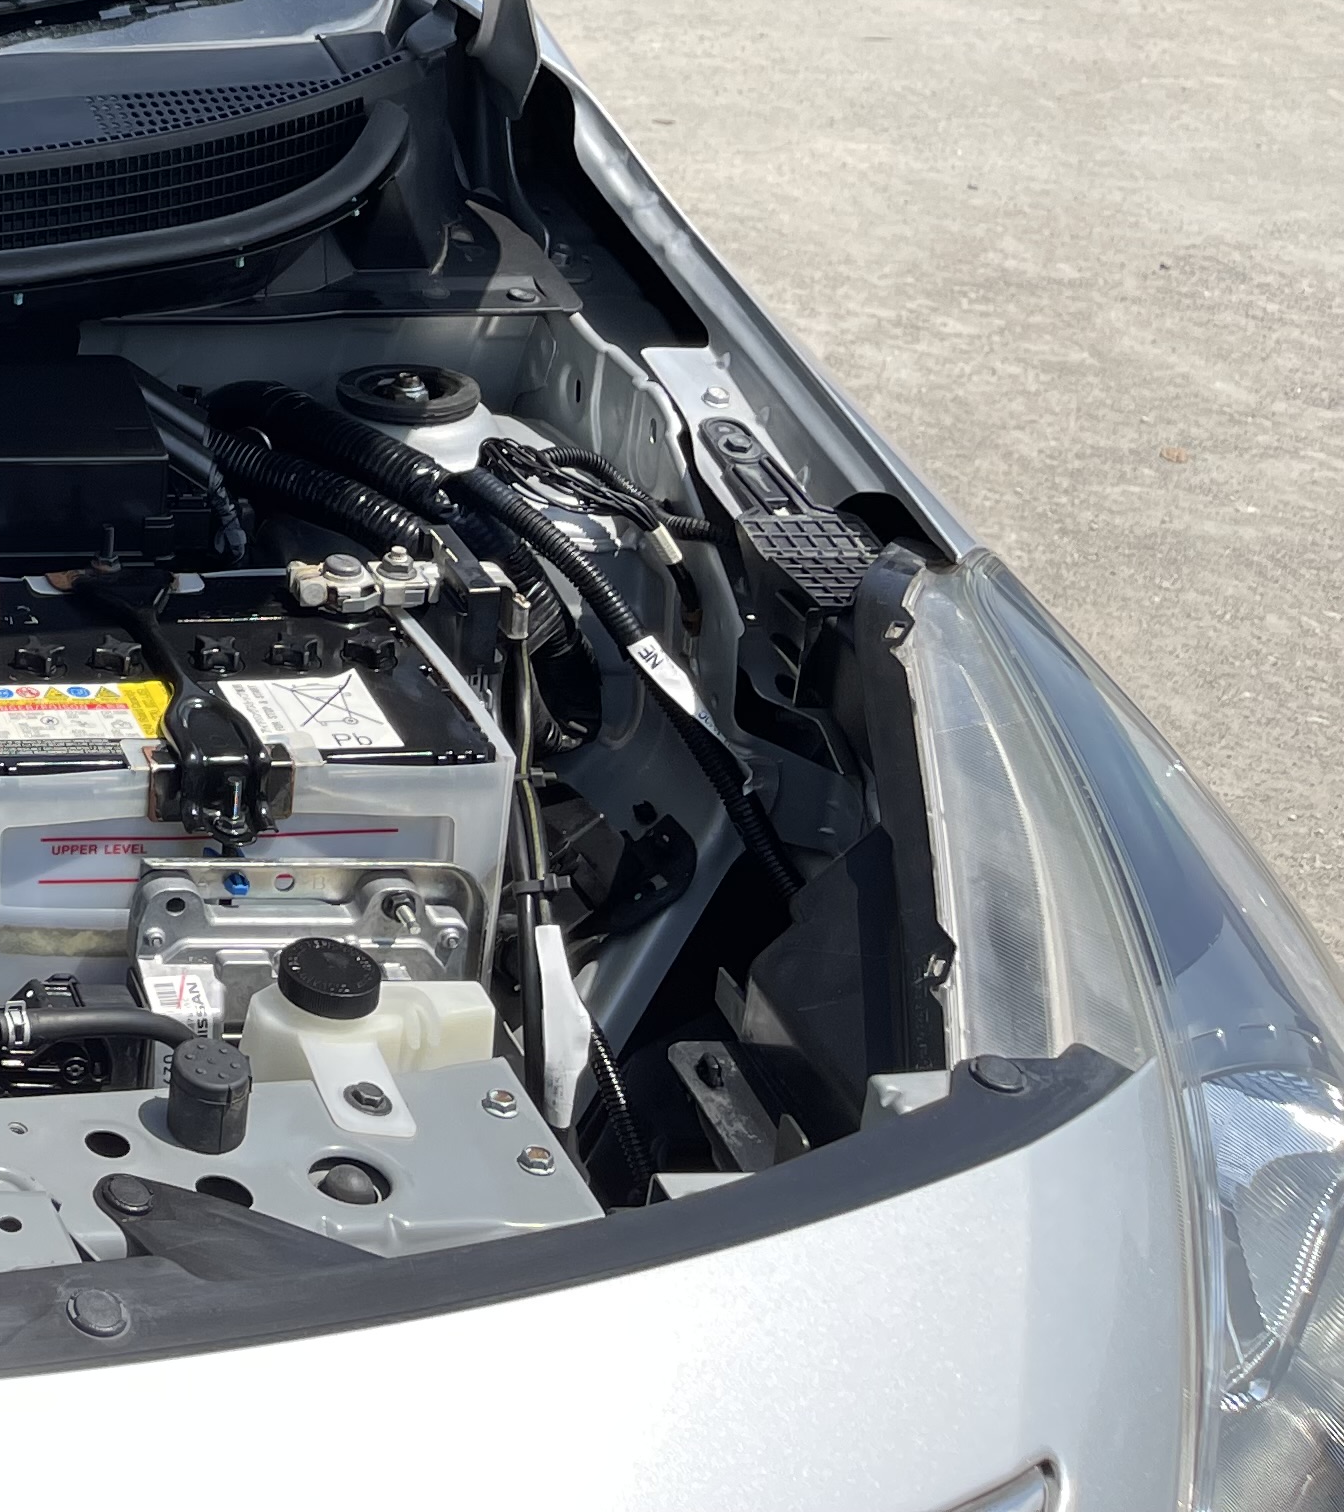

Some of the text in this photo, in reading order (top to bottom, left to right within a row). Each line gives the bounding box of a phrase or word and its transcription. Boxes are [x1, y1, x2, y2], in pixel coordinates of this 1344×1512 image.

[332, 733, 372, 746] Pb
[52, 844, 147, 855] UPPER LEVEL
